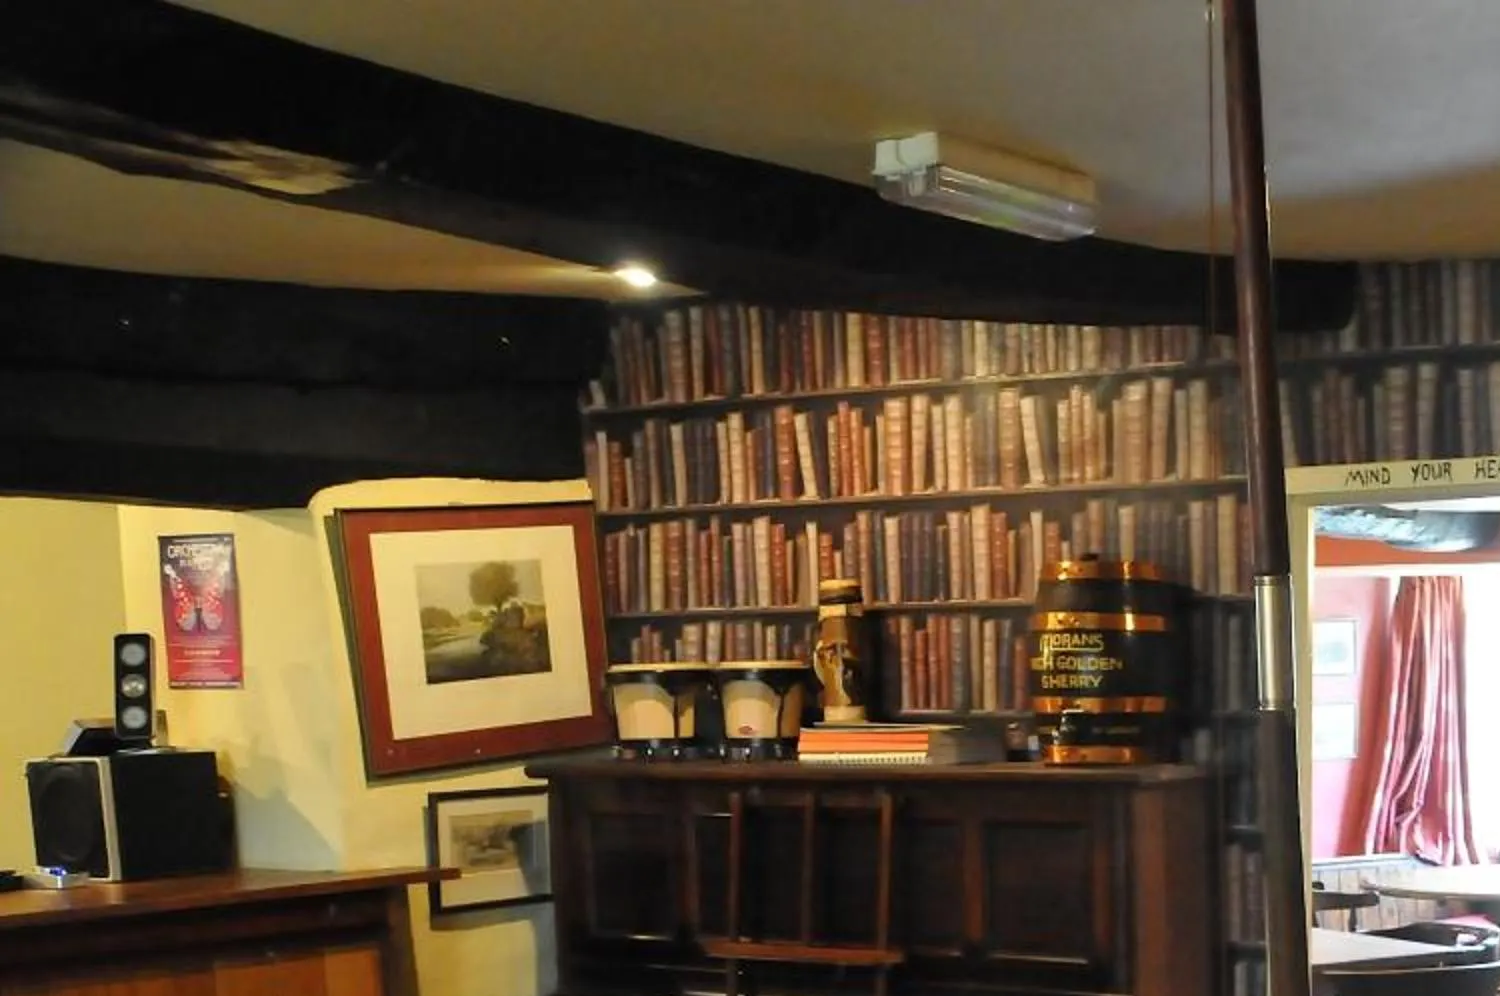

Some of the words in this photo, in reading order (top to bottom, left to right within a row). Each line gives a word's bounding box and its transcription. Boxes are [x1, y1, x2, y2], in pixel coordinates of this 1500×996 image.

[1345, 466, 1391, 487] MIND
[1411, 461, 1453, 483] YOUR
[1056, 655, 1123, 671] GOLDEN
[1041, 674, 1103, 689] SHERRY
